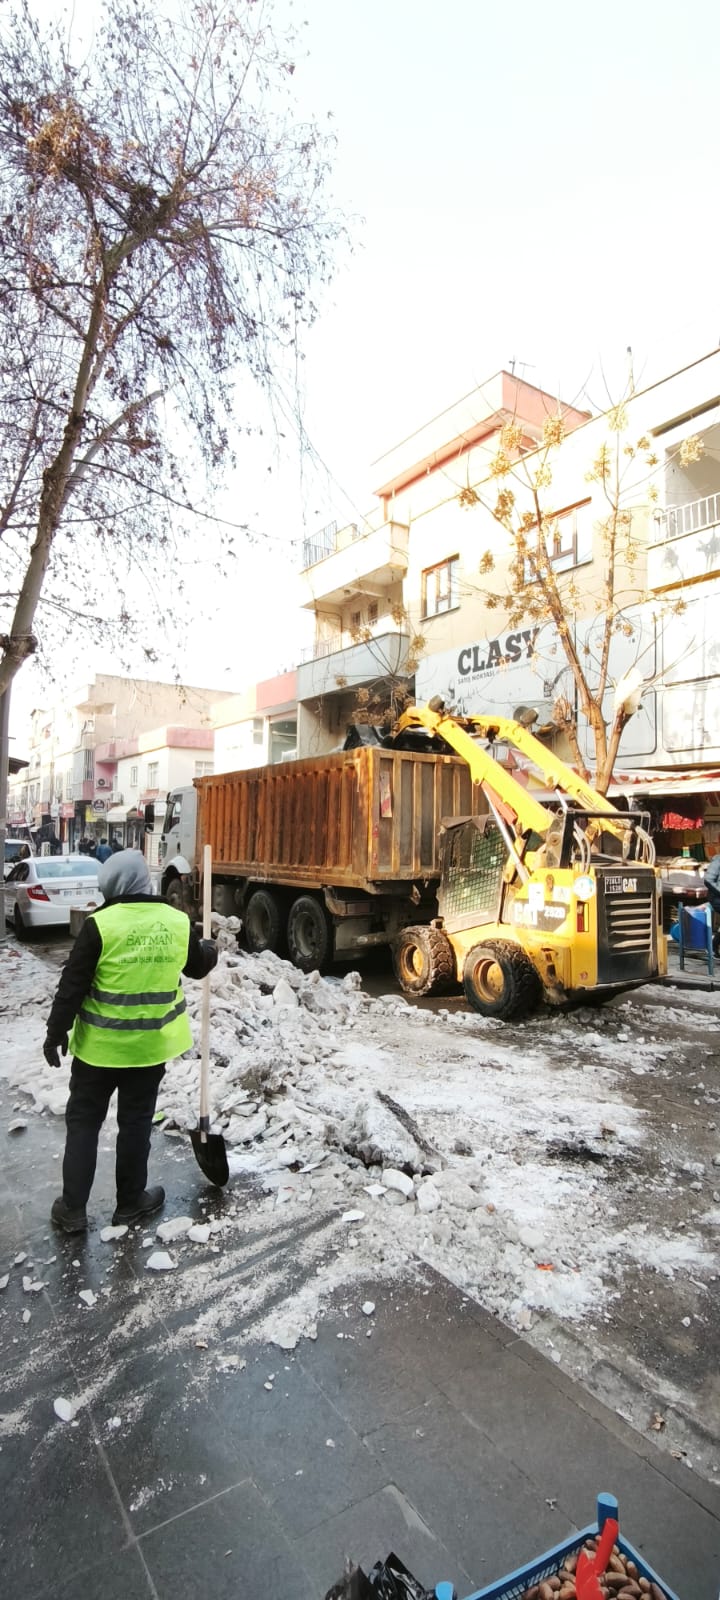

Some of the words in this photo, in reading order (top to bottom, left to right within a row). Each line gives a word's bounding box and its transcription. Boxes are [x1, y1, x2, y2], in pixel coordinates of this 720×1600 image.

[458, 628, 540, 675] CLASY
[623, 878, 637, 892] CAT
[126, 934, 173, 946] BATMAN
